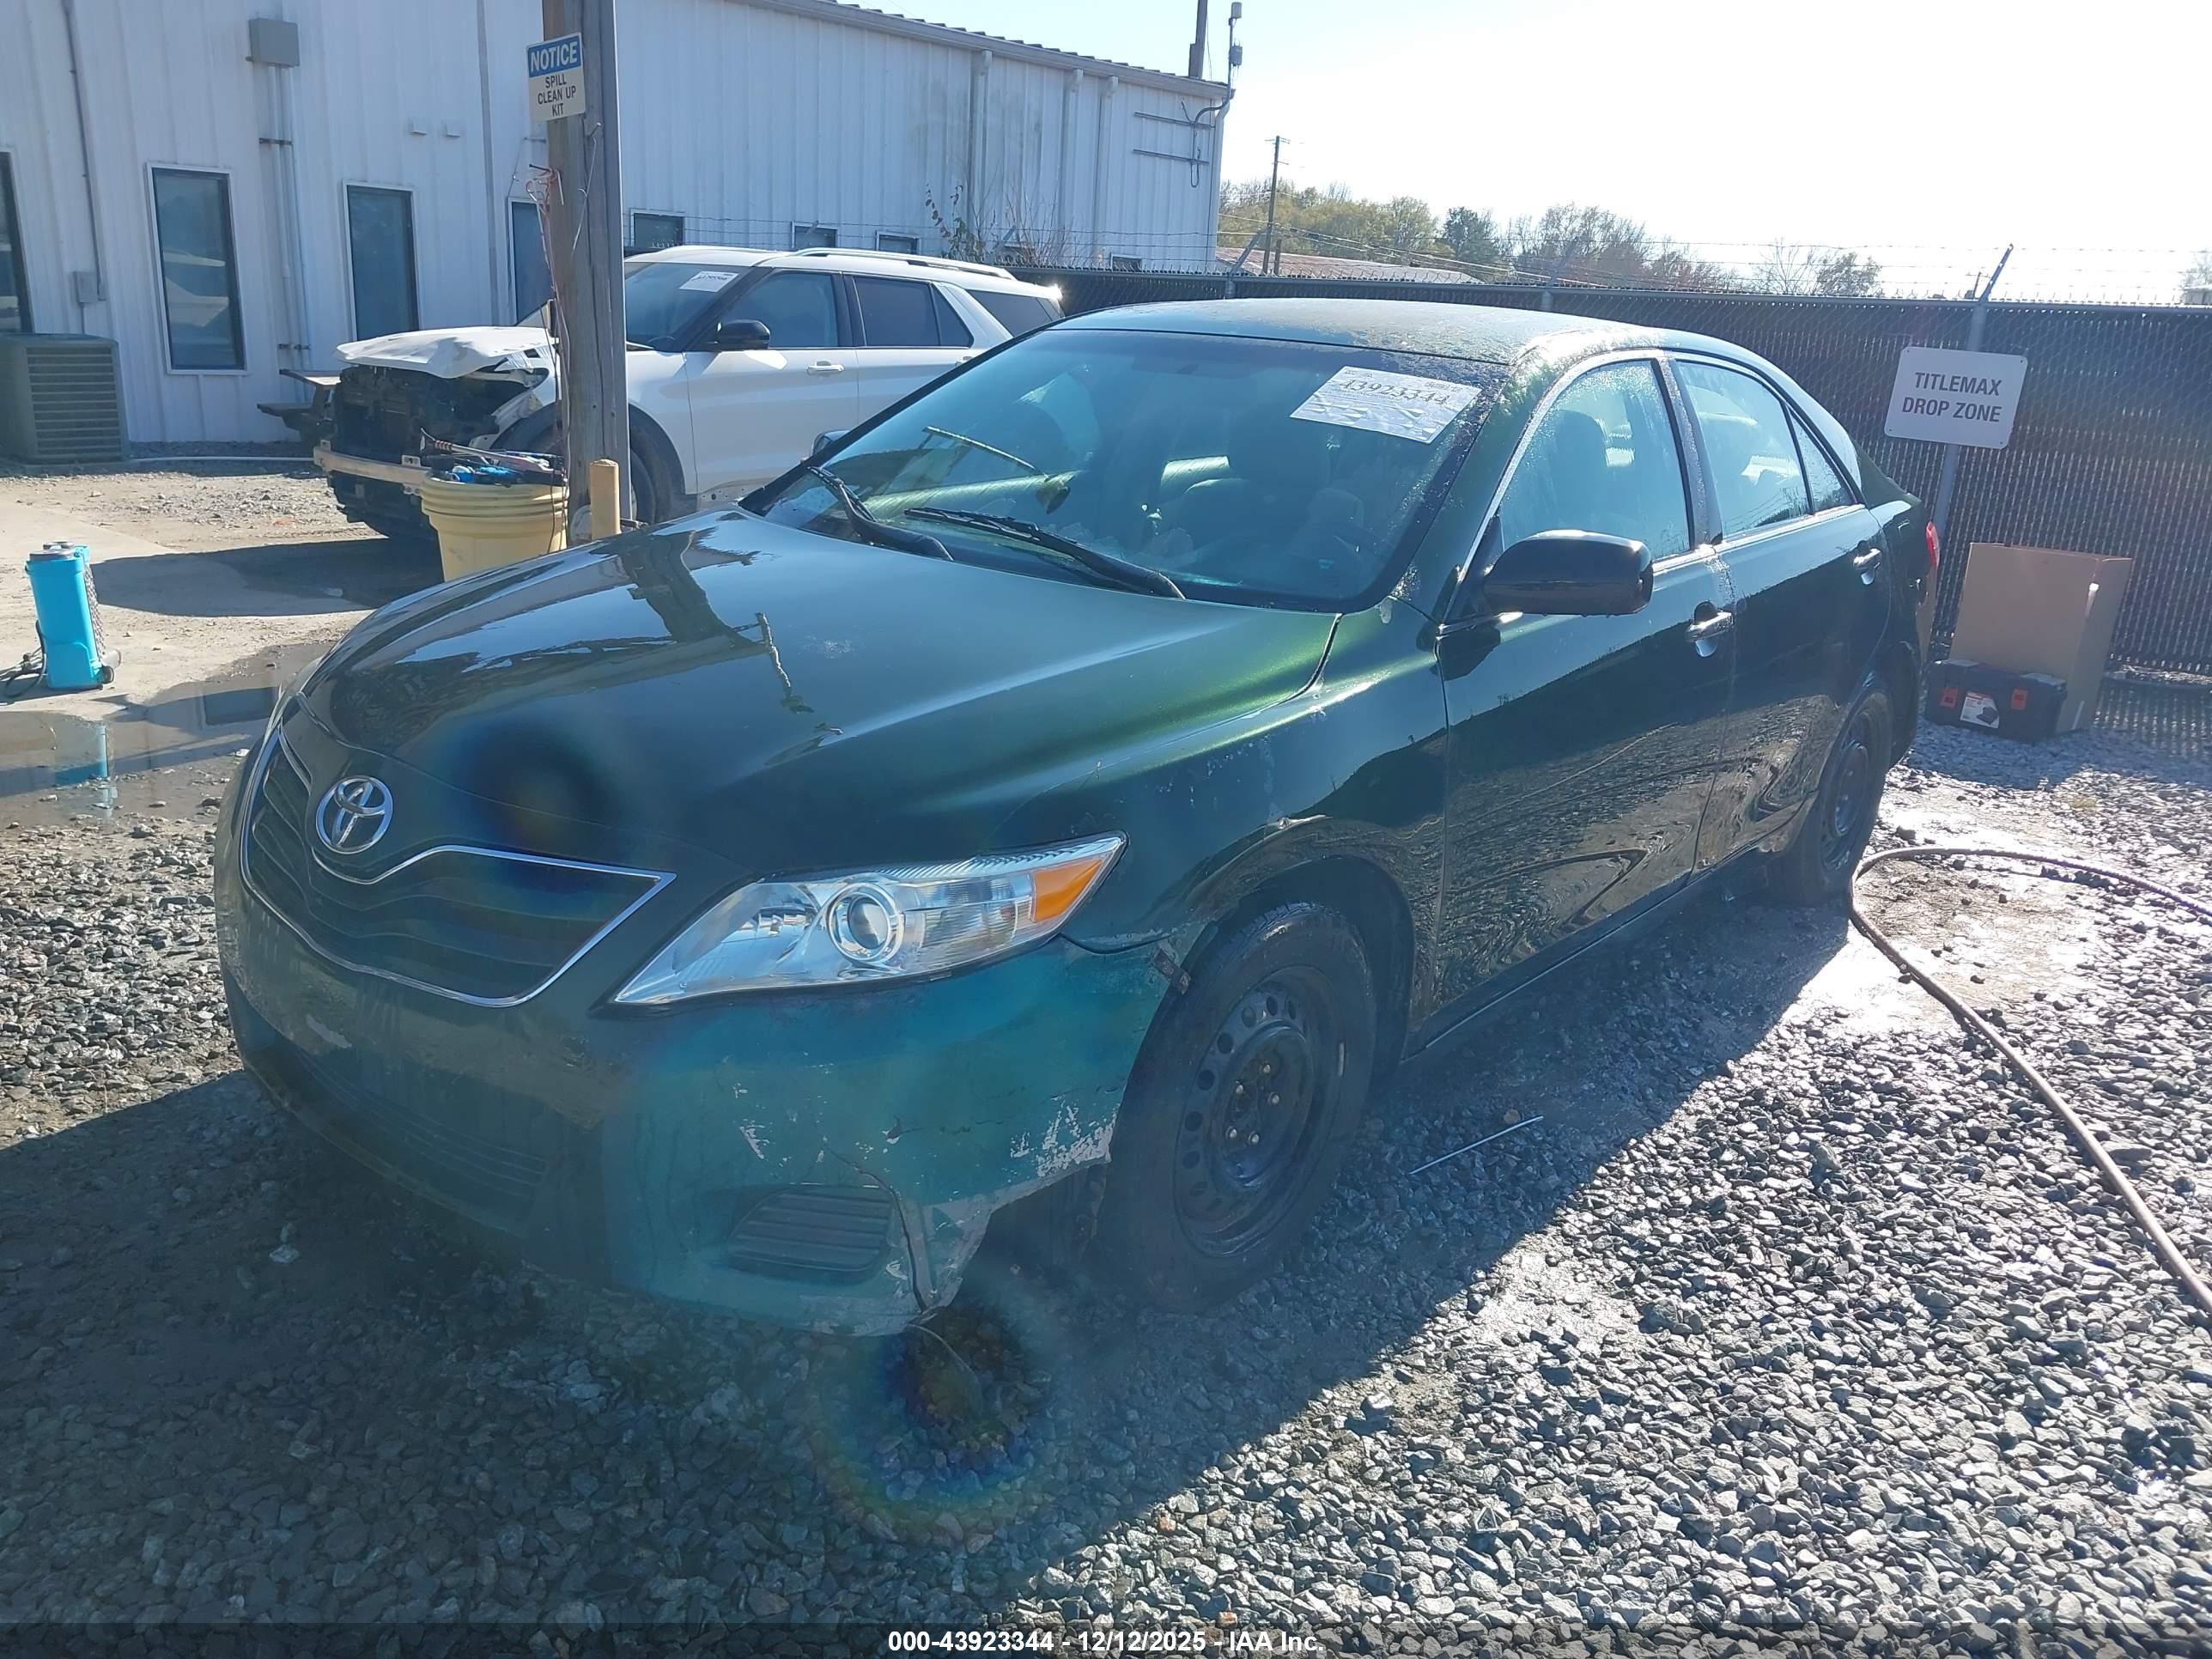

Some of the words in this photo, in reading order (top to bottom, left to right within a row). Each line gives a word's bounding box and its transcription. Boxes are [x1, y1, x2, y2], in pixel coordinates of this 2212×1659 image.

[531, 41, 578, 73] NOTICE
[545, 73, 567, 88] SPILL
[538, 88, 562, 105] CLEAN
[566, 85, 576, 99] UP
[551, 103, 564, 117] KIT
[1339, 379, 1451, 405] 43923344
[1915, 372, 2002, 396] TITLEMAX
[1902, 397, 1950, 416] DROP
[1953, 402, 2002, 422] ZONE
